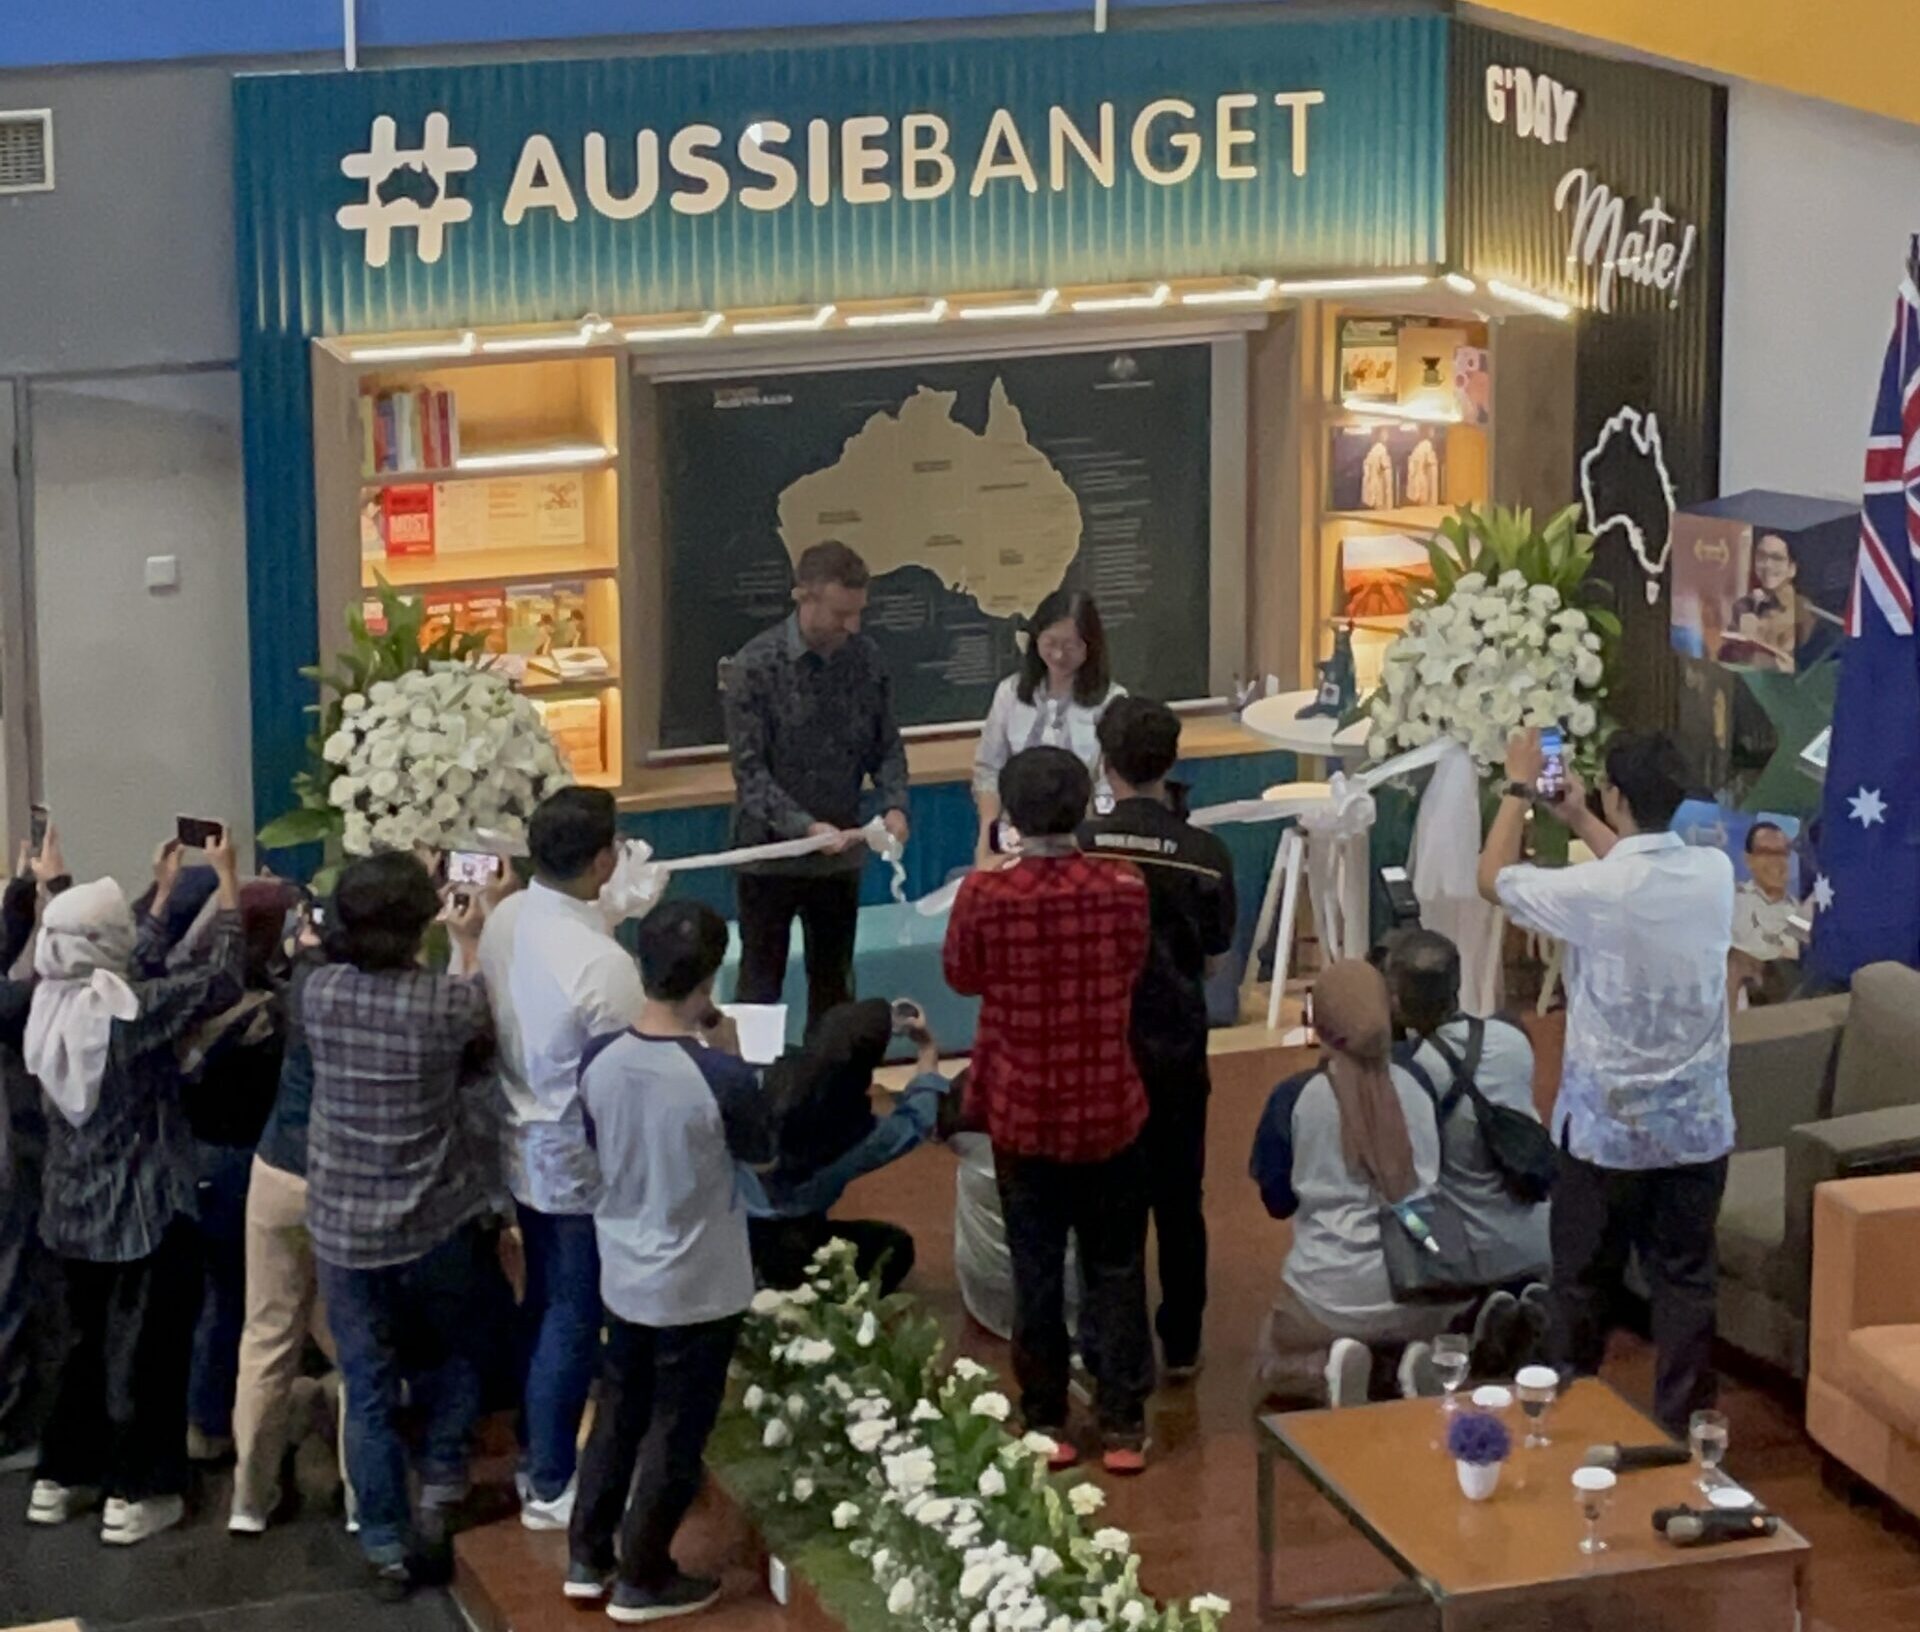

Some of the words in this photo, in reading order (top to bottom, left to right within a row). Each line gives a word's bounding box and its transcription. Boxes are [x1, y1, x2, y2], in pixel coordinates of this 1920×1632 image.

[1486, 65, 1577, 145] G'DAY
[336, 91, 1326, 268] #AUSSIEBANGET
[1555, 168, 1697, 314] Mate!
